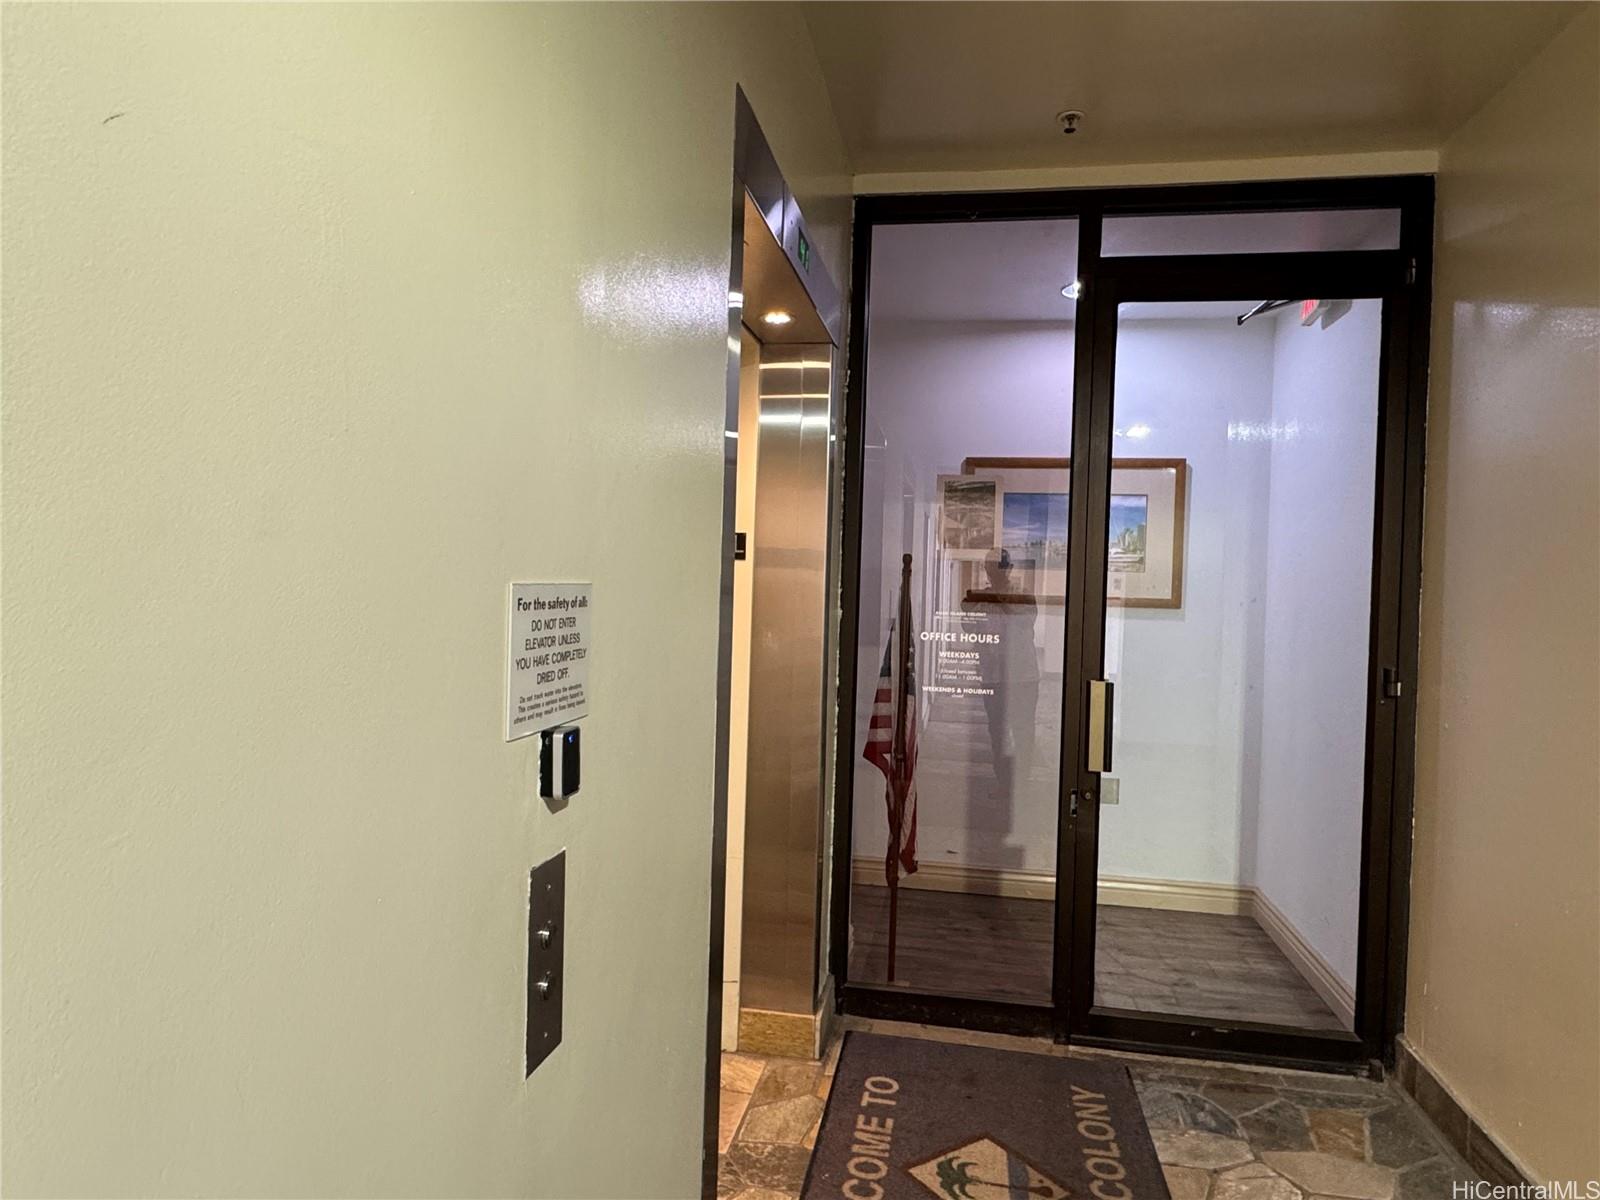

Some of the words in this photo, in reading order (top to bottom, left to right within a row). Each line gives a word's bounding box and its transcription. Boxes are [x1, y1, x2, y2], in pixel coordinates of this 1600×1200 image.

[517, 597, 531, 611] For
[533, 596, 546, 611] the
[548, 596, 569, 612] safety
[570, 596, 578, 608] of
[531, 619, 542, 632] DO
[544, 618, 557, 630] NOT
[558, 616, 576, 629] ENTER
[525, 636, 556, 650] ELEVATOR
[558, 632, 580, 646] UNLESS
[920, 632, 956, 642] OFFICE
[960, 633, 1000, 644] HOURS
[516, 656, 531, 670] YOU
[532, 654, 550, 668] HAVE
[552, 648, 587, 664] COMPLETELY
[939, 651, 980, 659] WEEKDAYS
[537, 670, 555, 685] DRIED
[557, 668, 570, 680] OFF.
[861, 1076, 899, 1106] TO
[1070, 1084, 1132, 1200] COLONY
